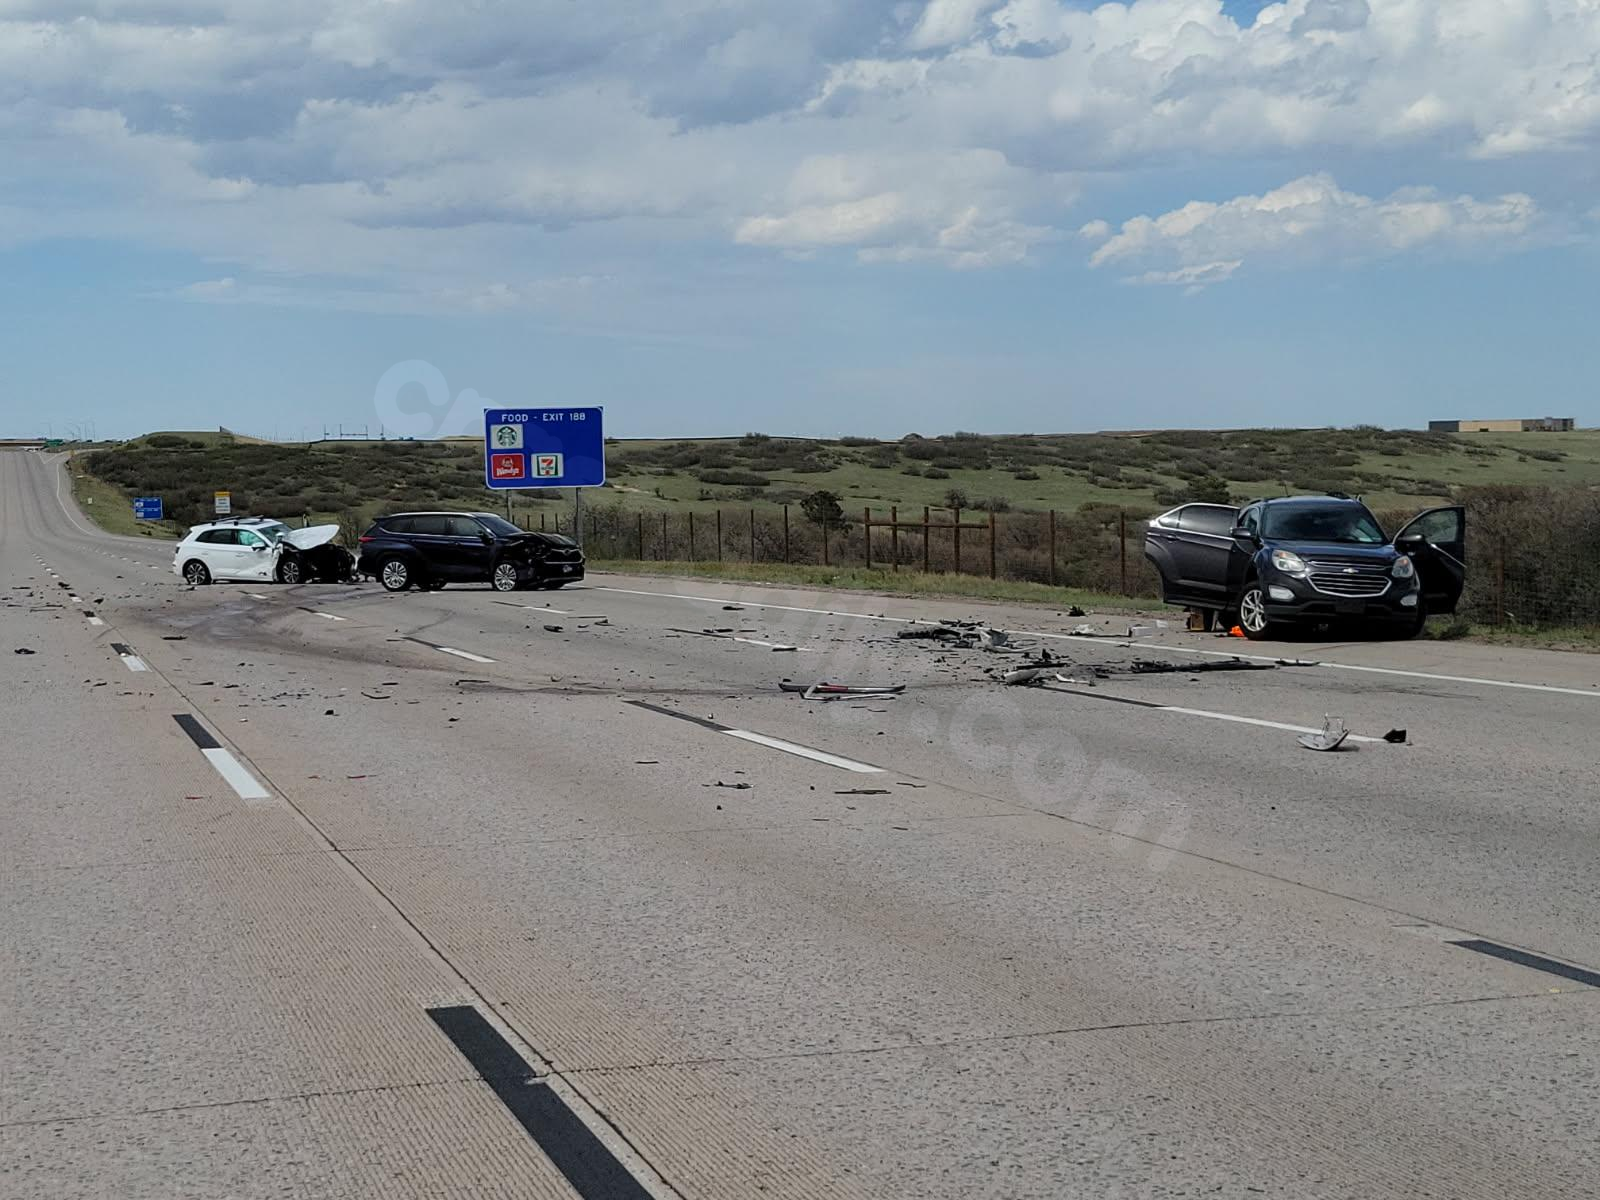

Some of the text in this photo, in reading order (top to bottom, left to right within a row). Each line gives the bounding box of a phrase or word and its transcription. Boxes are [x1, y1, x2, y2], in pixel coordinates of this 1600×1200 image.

[501, 413, 529, 422] FOOD
[542, 413, 564, 422] EXIT
[569, 412, 586, 421] 188
[496, 467, 520, 477] Wendys
